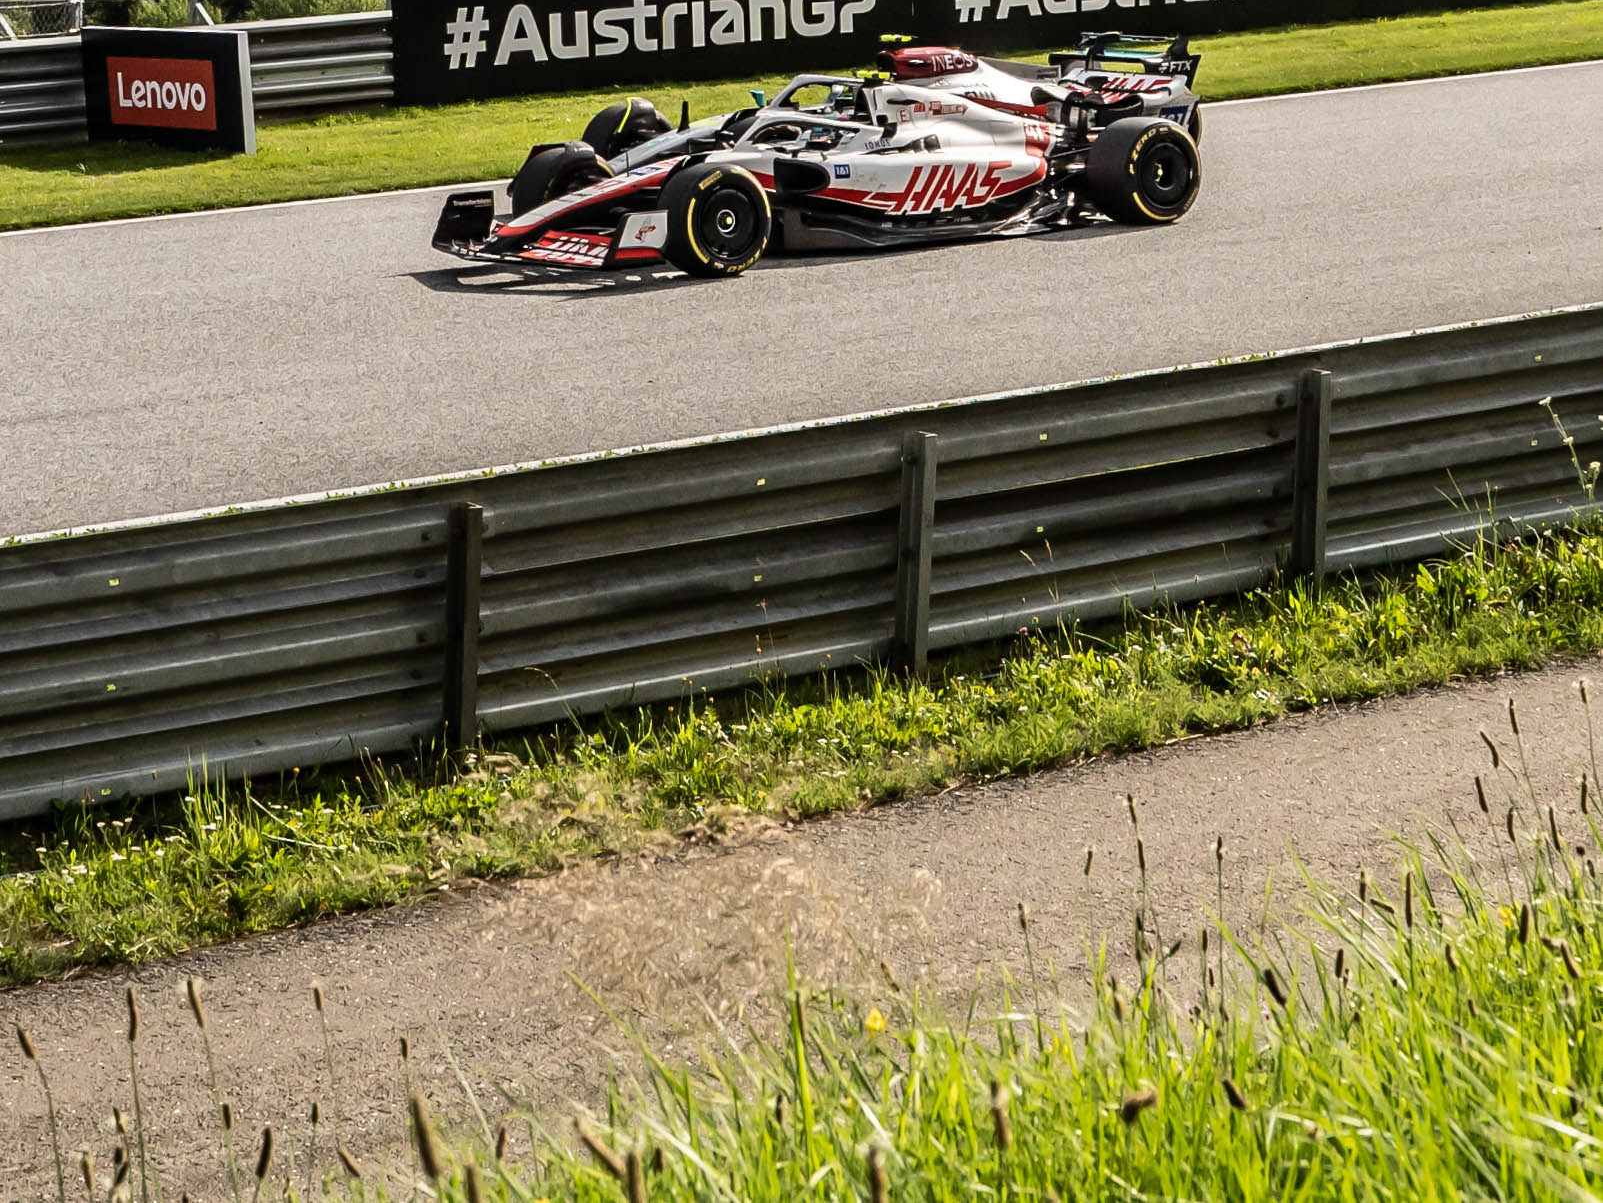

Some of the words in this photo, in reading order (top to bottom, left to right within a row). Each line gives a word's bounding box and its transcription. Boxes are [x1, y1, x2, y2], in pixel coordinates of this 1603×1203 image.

[931, 53, 974, 72] INEOS
[1169, 60, 1193, 73] FTX
[118, 72, 205, 111] Lenovo
[890, 161, 1013, 213] HAAS
